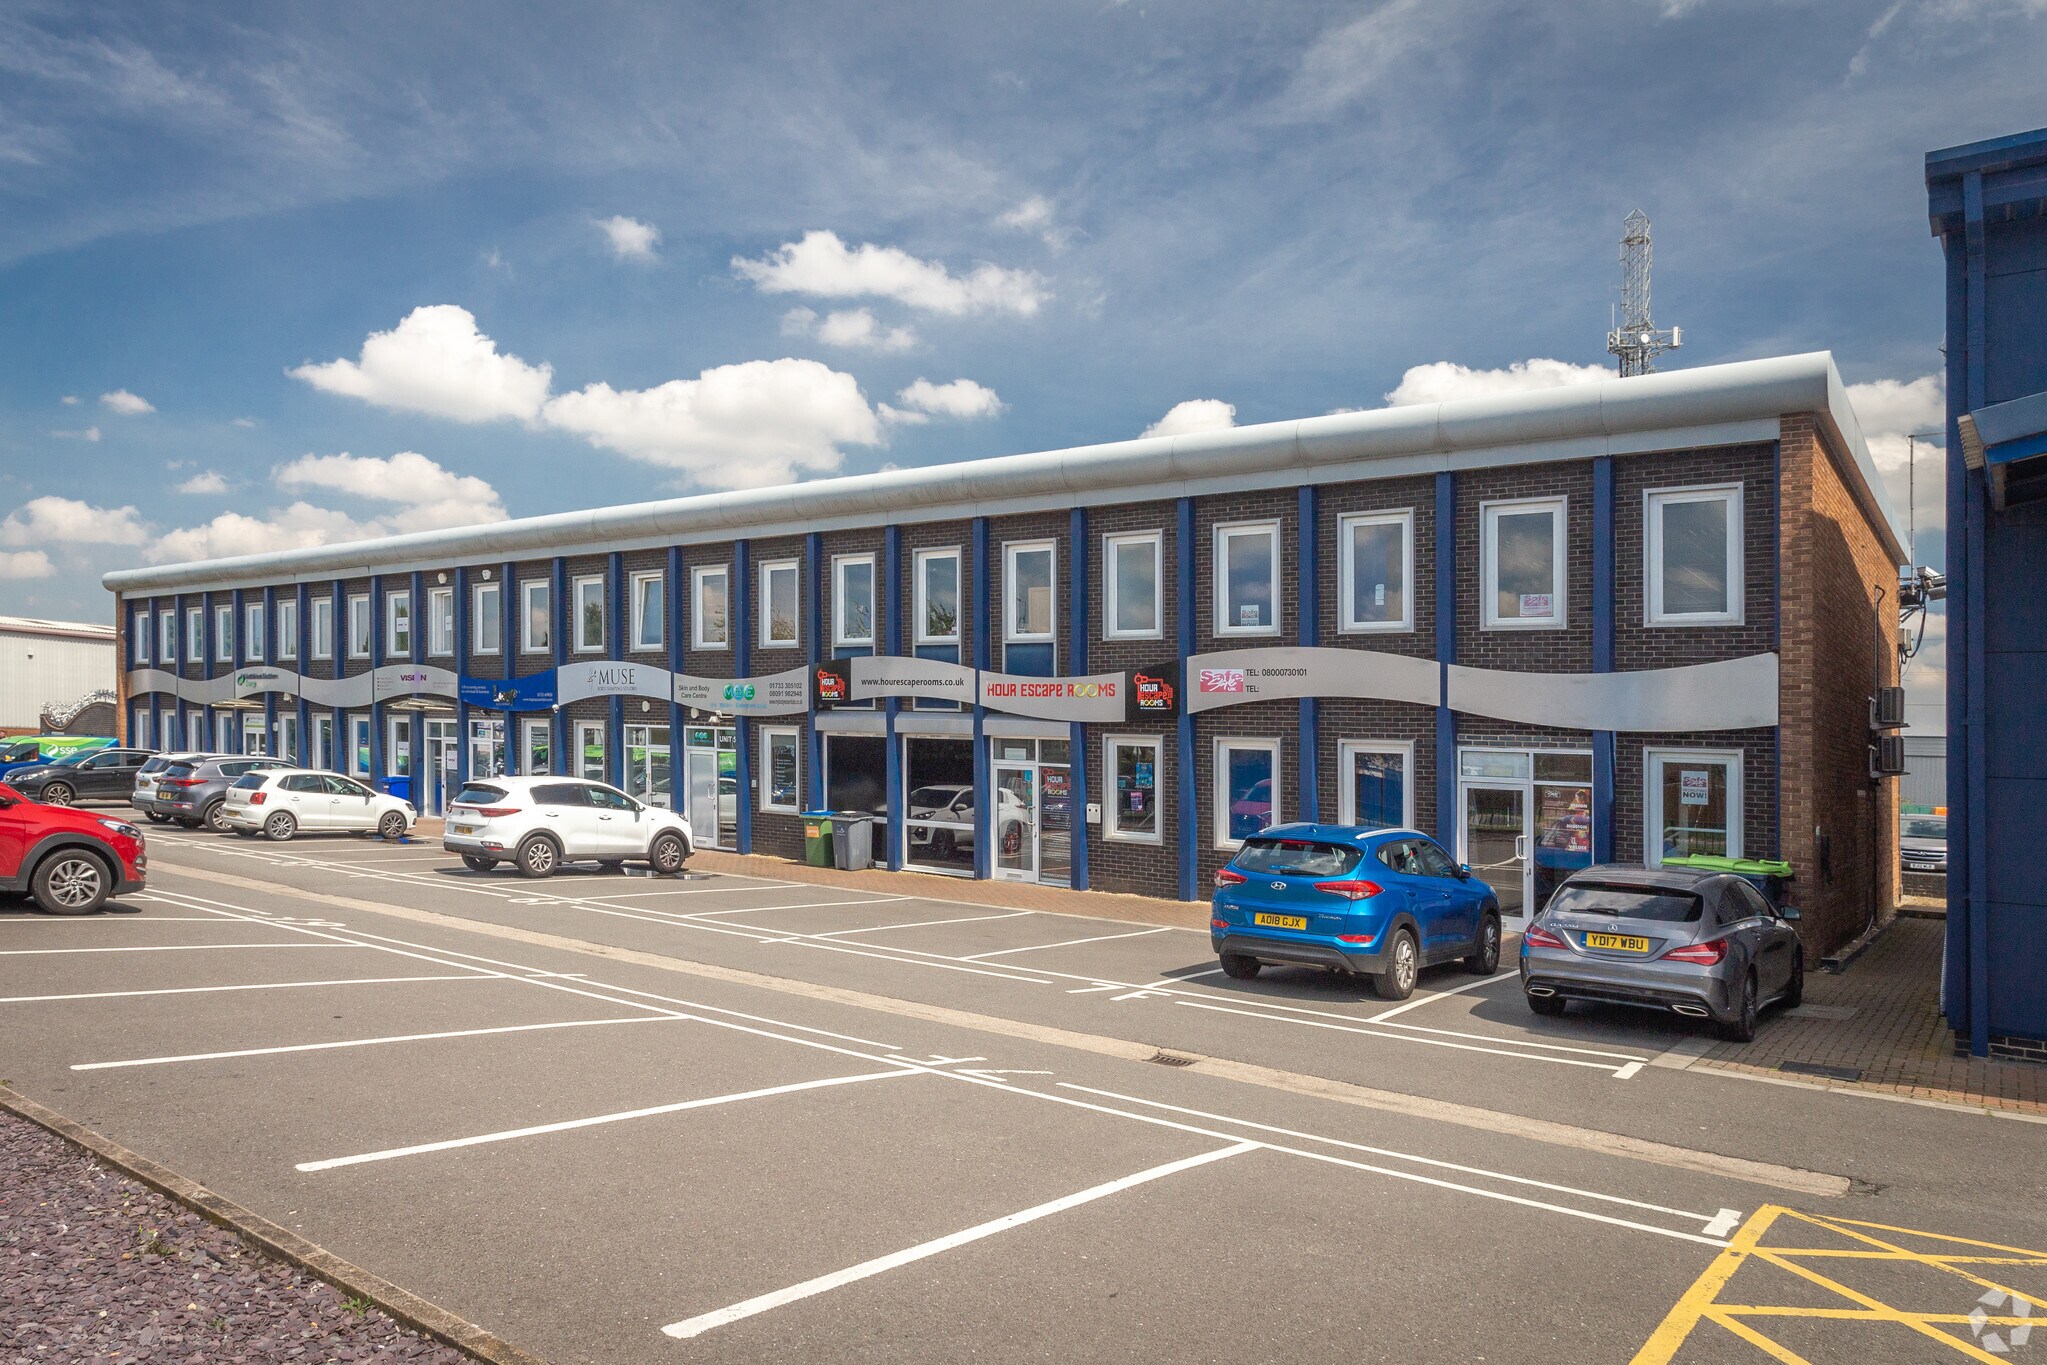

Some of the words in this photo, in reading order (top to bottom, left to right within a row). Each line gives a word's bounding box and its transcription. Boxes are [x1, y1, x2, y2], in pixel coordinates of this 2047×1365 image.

[598, 668, 635, 685] MUSE
[1201, 670, 1243, 681] Safe
[1262, 668, 1307, 677] 08000730101
[861, 678, 964, 688] www.hourescaperooms.co.uk
[1140, 684, 1158, 692] HOUR
[987, 683, 1017, 697] HOUR
[1067, 683, 1116, 698] ROOMS
[1140, 699, 1164, 707] ROOMS
[59, 746, 78, 755] sse
[1260, 914, 1280, 926] AO18
[1282, 916, 1301, 928] GJX
[1591, 935, 1618, 948] YD17
[1620, 937, 1644, 950] WBU
